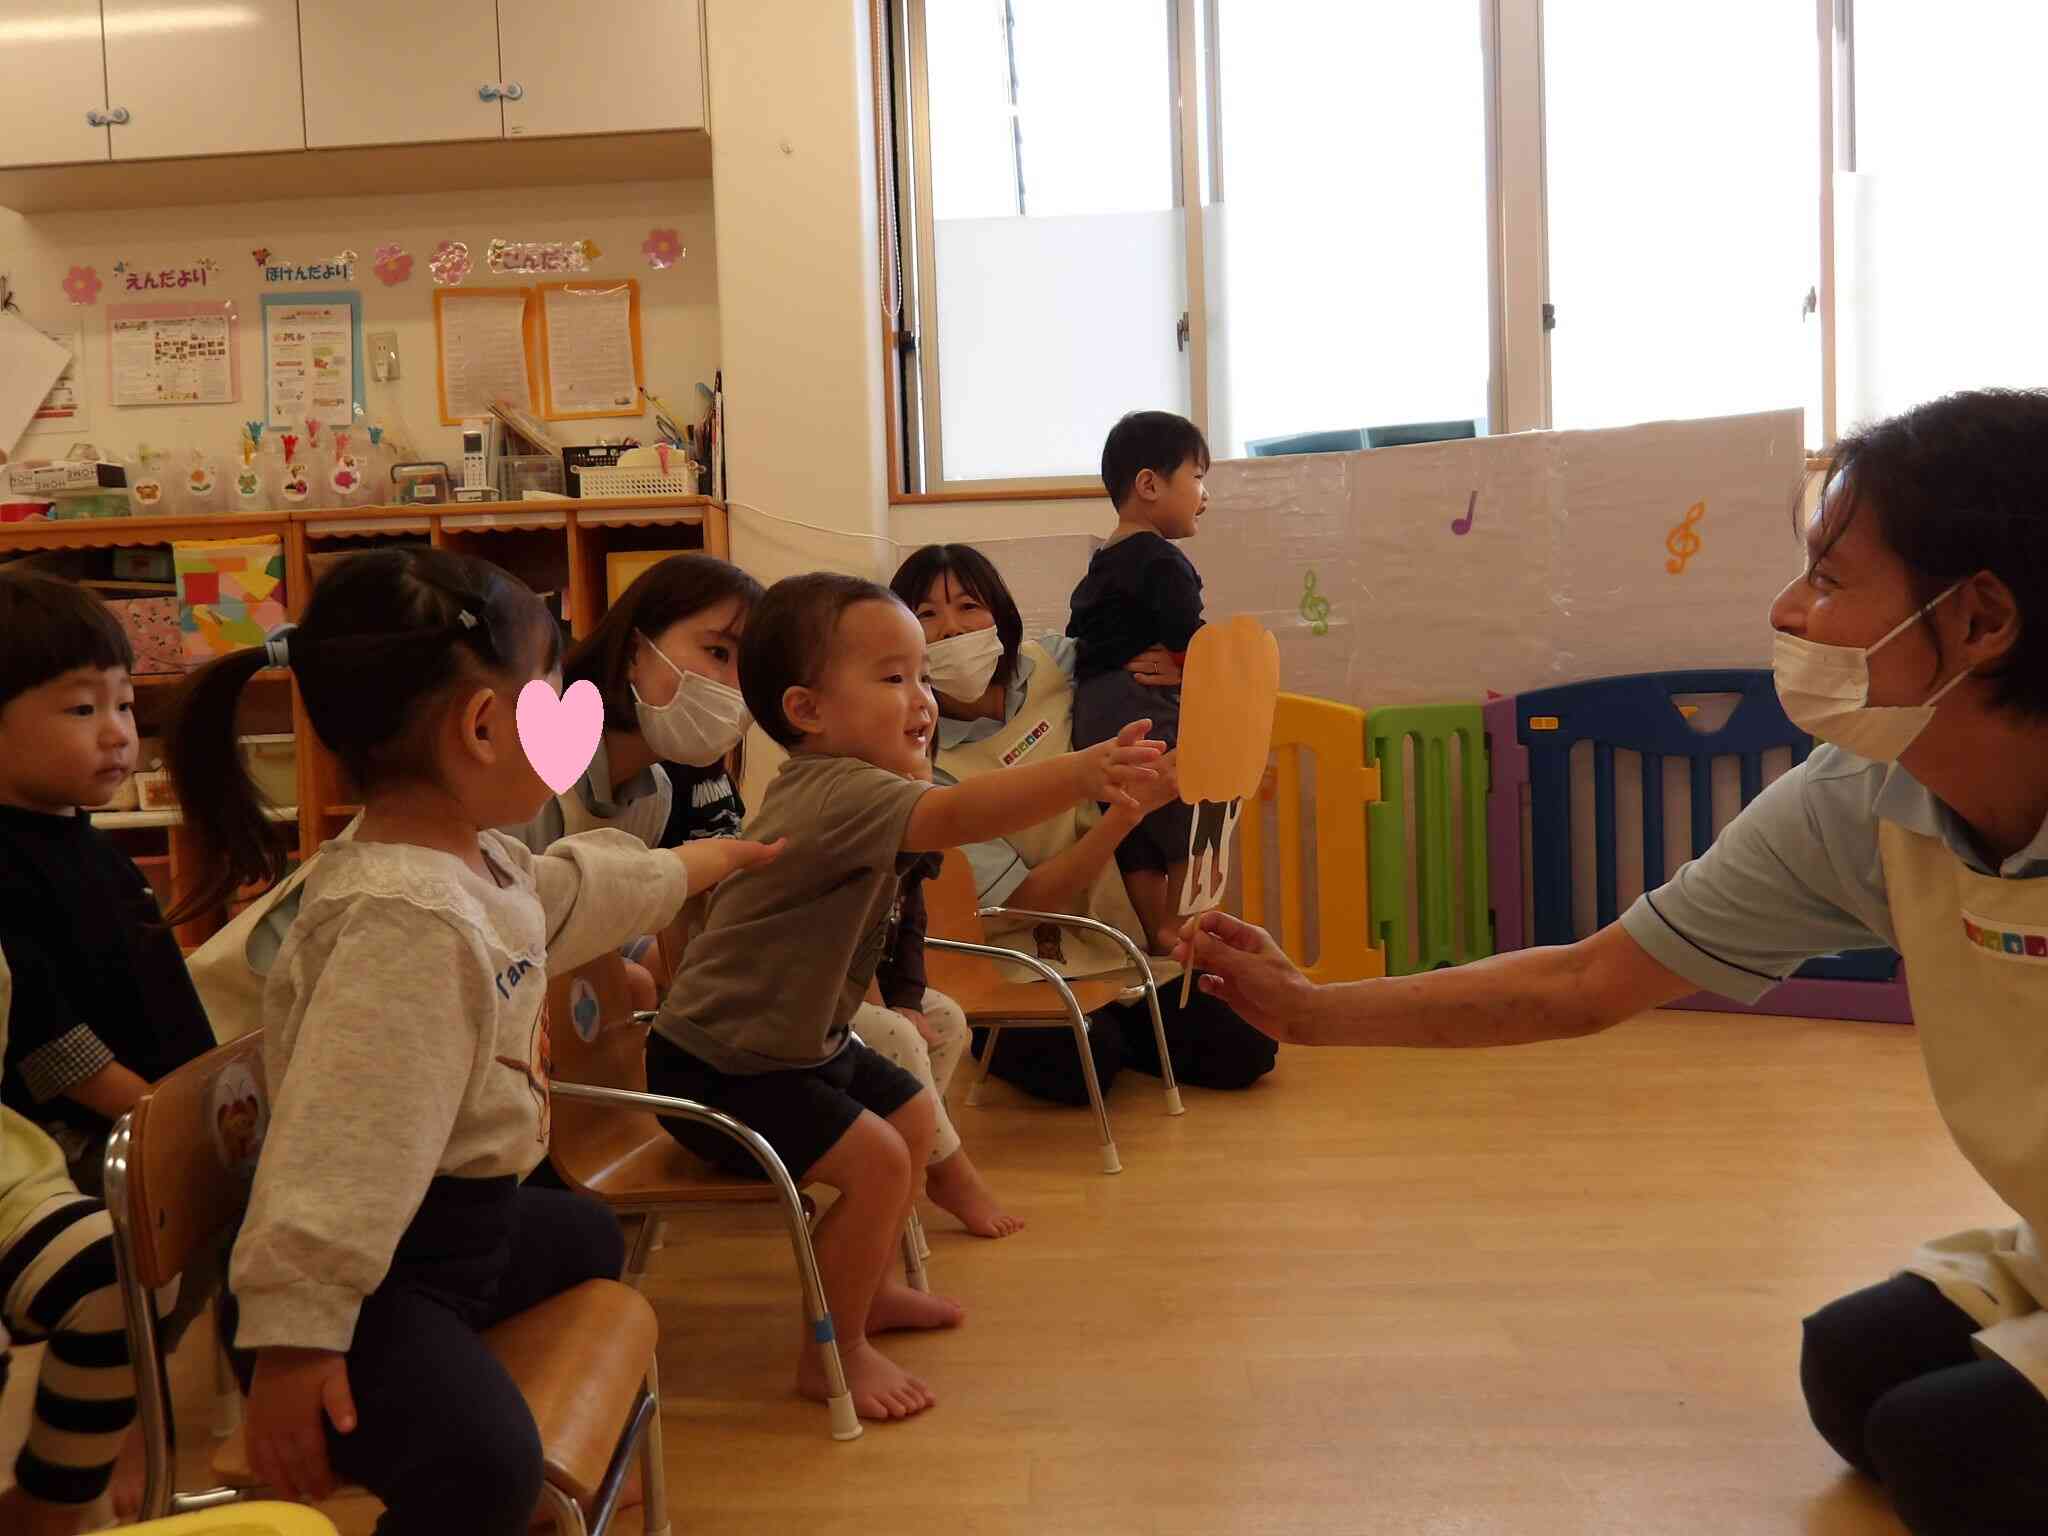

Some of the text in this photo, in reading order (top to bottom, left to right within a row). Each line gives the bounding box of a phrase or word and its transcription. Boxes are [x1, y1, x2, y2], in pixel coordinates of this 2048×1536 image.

[126, 268, 207, 290] えんだより
[264, 264, 348, 281] ほけんだより
